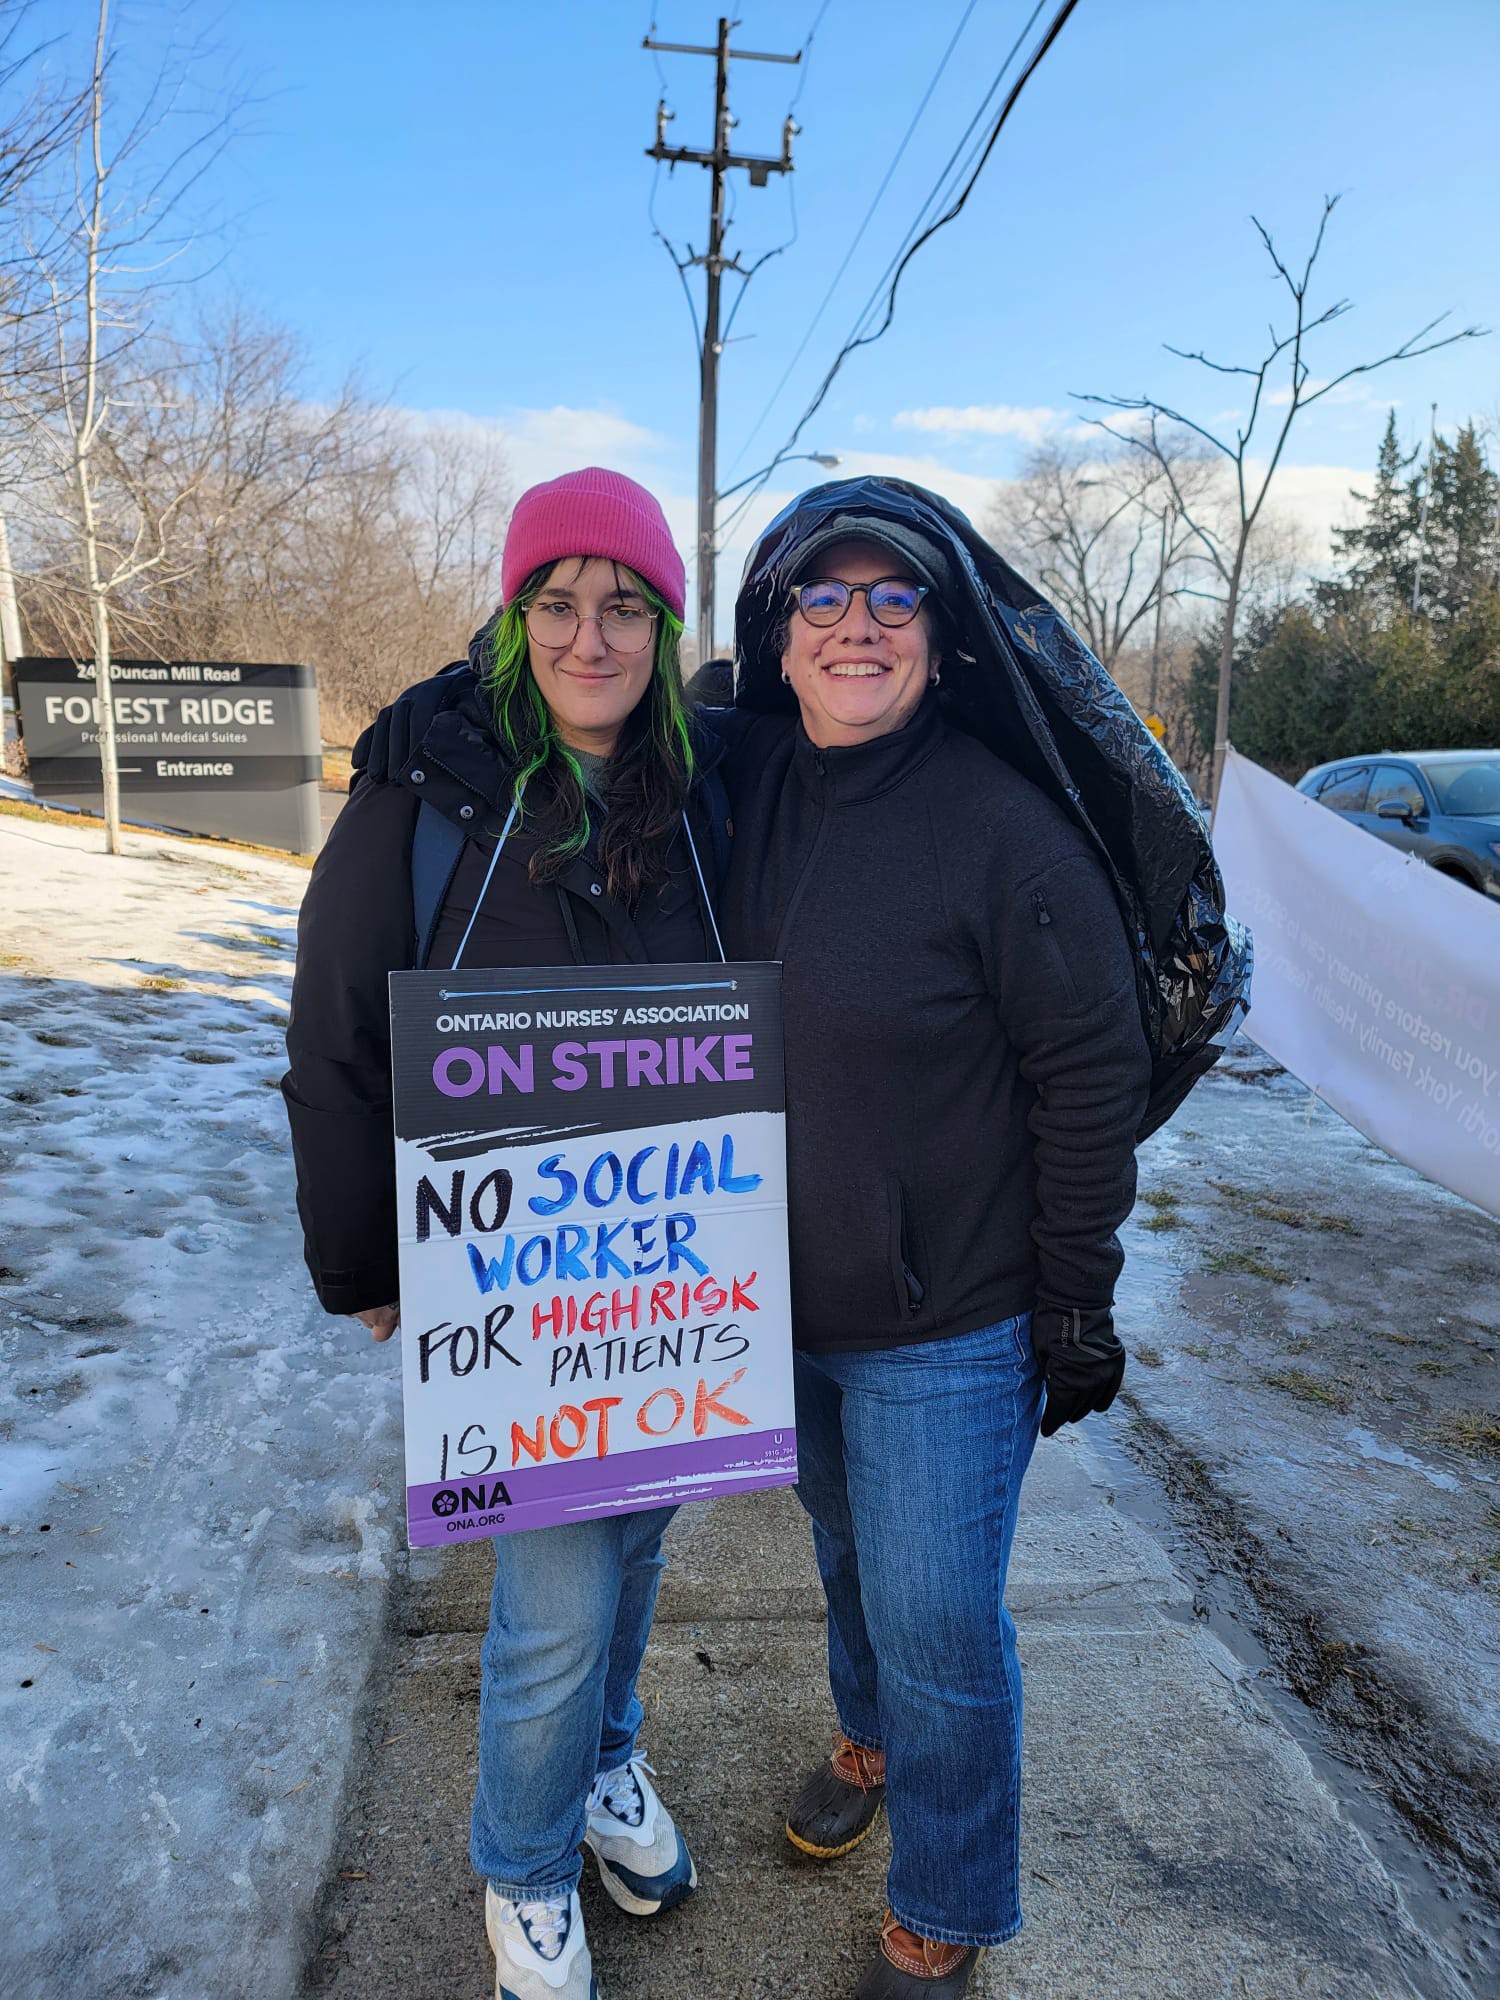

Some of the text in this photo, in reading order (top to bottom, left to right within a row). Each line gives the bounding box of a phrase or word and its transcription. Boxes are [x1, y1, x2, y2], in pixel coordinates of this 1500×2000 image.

[77, 664, 241, 682] 24 Duncan Mill Road
[181, 698, 274, 725] RIDGE
[162, 731, 209, 743] Medical
[212, 731, 247, 743] Suites
[156, 760, 234, 777] Entrance
[435, 1003, 749, 1033] ONTARIO NURSES' ASSOCIATION
[432, 1034, 755, 1098] ON STRIKE
[416, 1133, 764, 1243] NO SOCIAL
[466, 1212, 710, 1295] WORKER
[417, 1304, 523, 1383] FOR
[549, 1323, 751, 1387] PATIENTS
[439, 1367, 753, 1481] IS NOT OK
[431, 1481, 513, 1518] ONA
[446, 1513, 506, 1532] ONA.ORG
